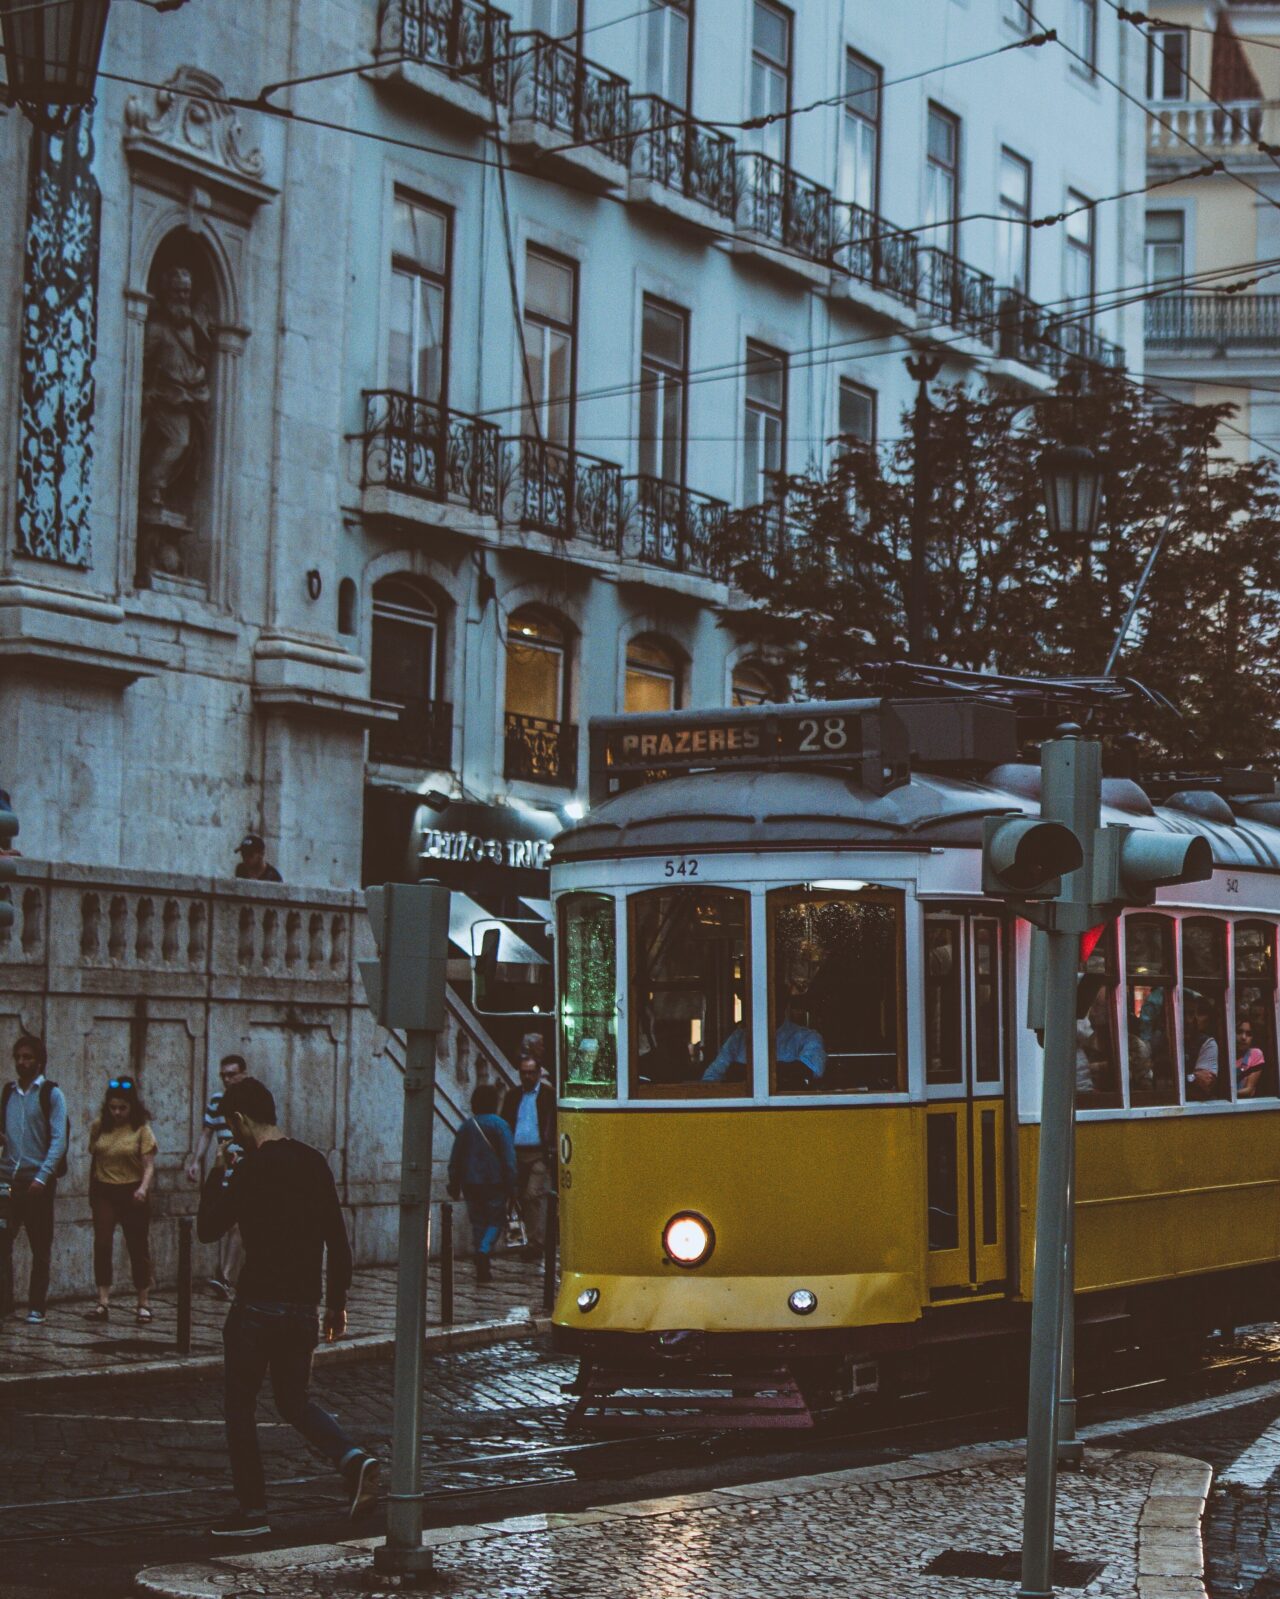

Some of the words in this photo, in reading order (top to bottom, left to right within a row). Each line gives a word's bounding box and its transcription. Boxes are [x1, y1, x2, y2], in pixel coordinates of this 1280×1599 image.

[623, 728, 759, 756] PRAZERES
[798, 718, 848, 752] 28
[664, 859, 699, 877] 542
[1226, 878, 1240, 893] 542
